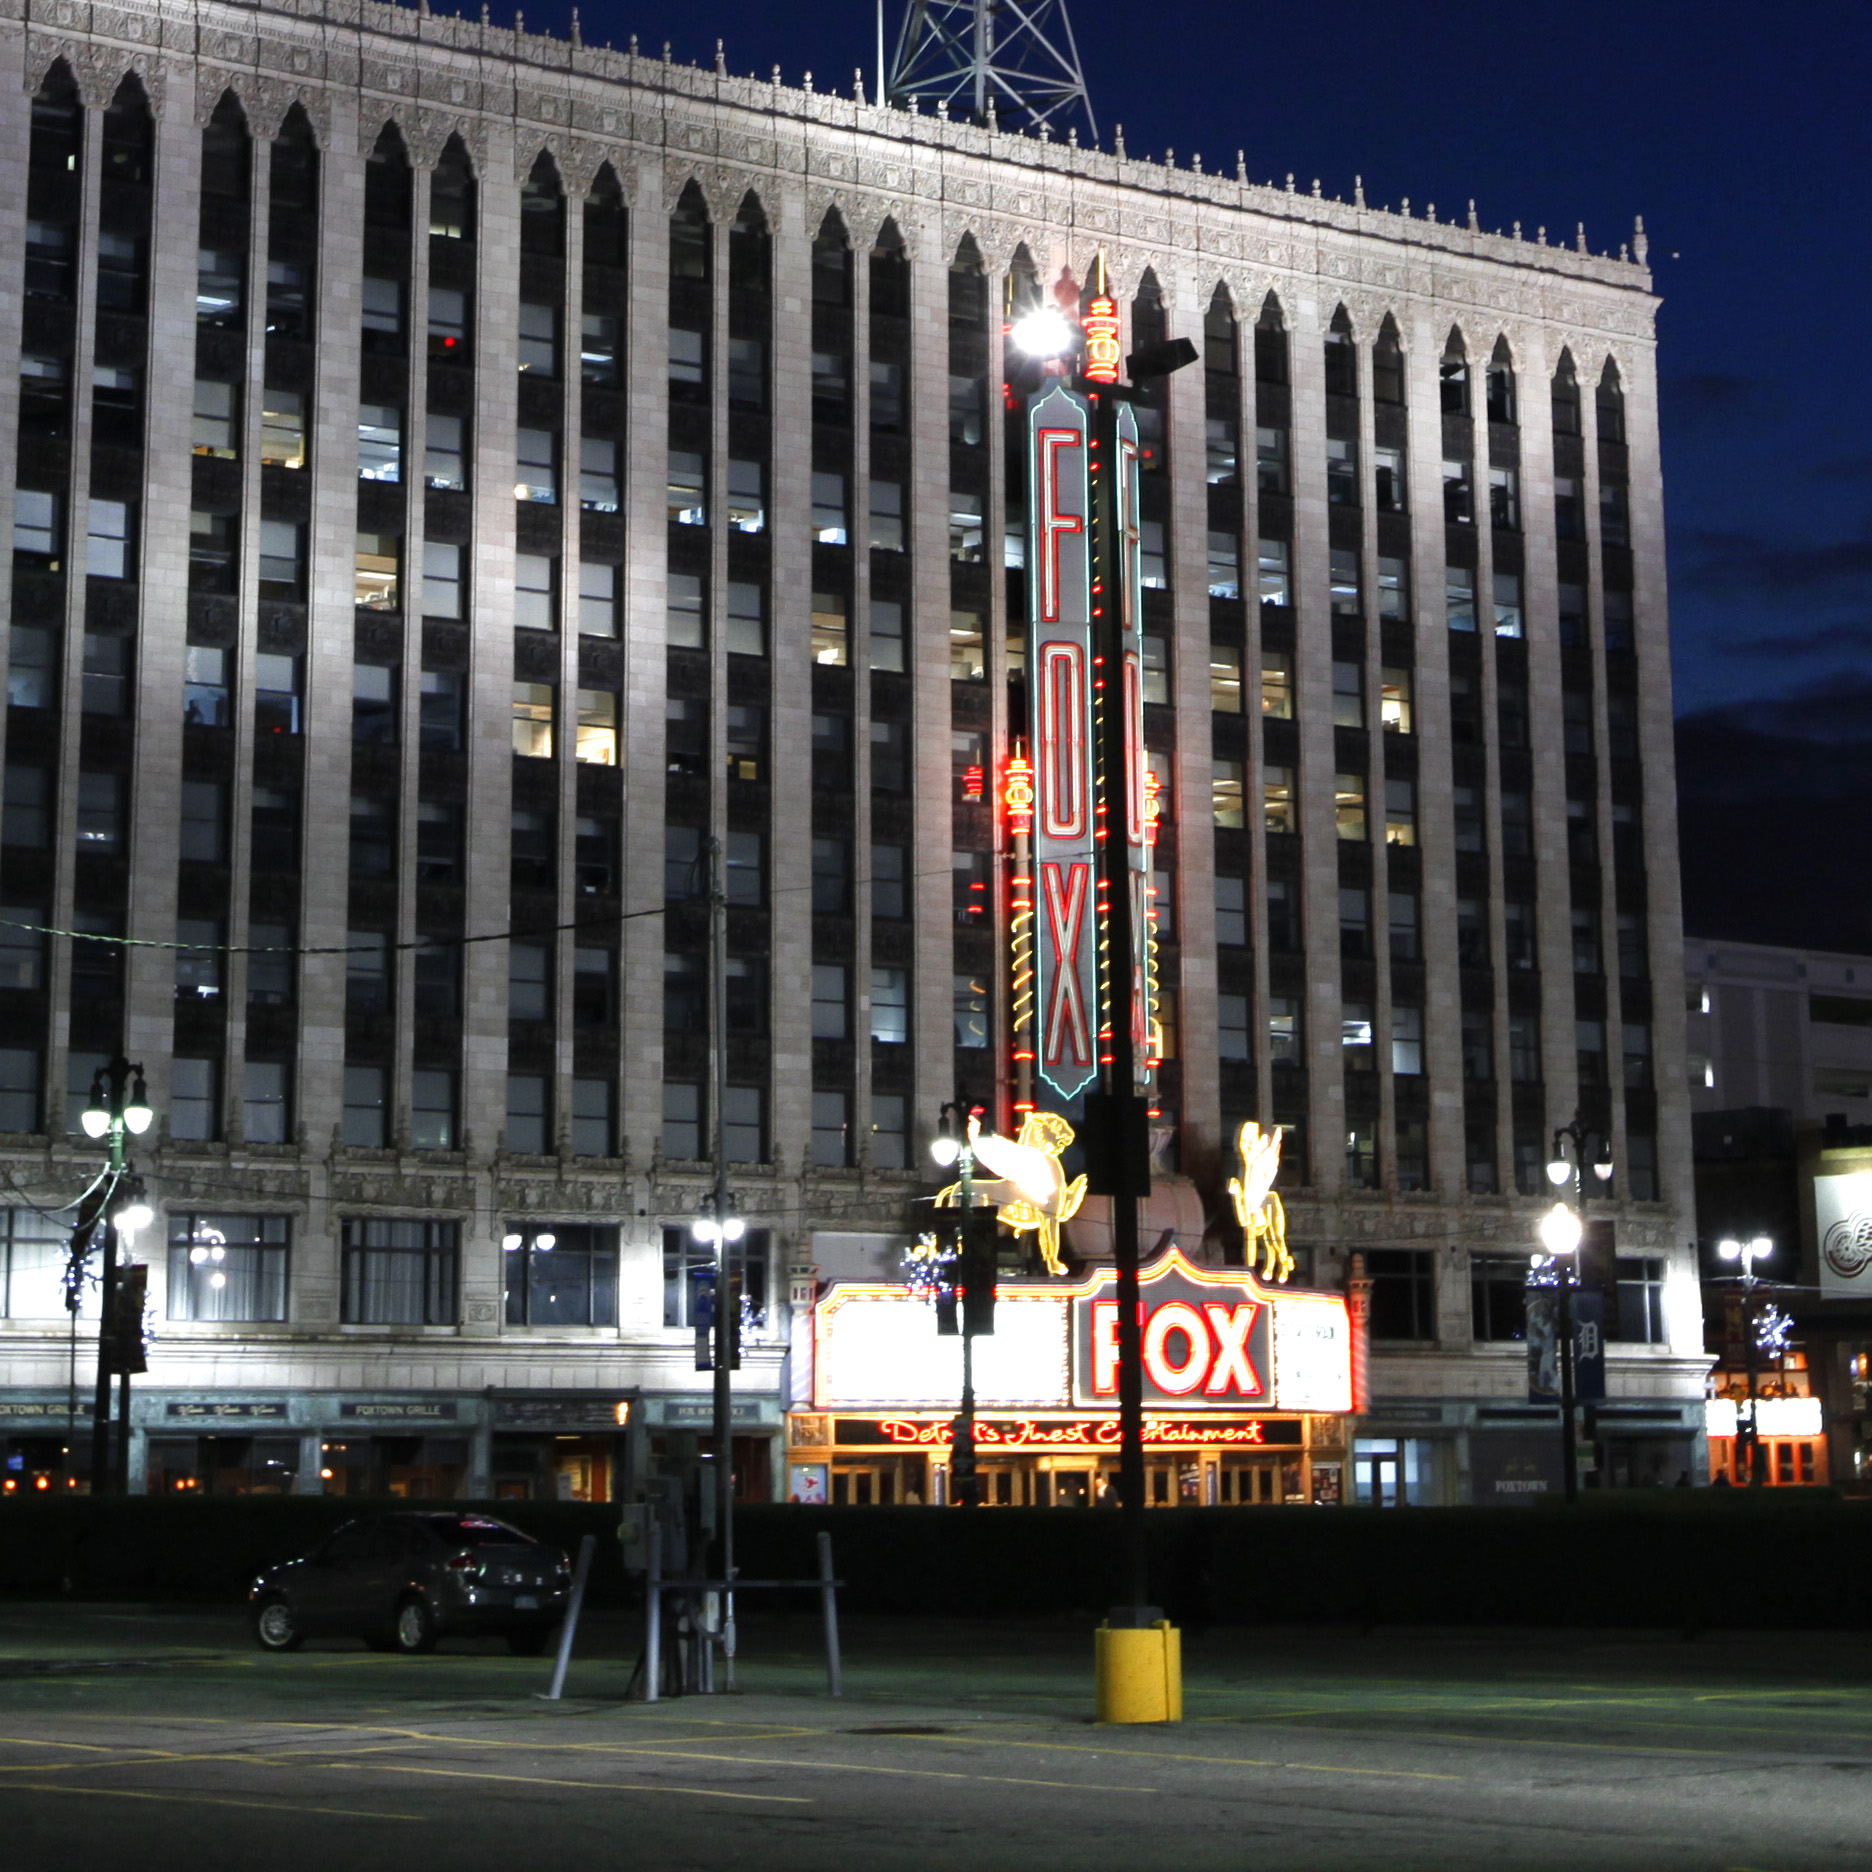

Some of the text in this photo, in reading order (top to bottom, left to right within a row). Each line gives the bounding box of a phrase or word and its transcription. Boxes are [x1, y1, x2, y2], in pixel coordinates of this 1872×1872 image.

[1039, 428, 1091, 1065] FOX
[1091, 1299, 1264, 1396] FOX
[355, 1405, 404, 1416] FOXTOWN
[879, 1419, 1264, 1446] Detrt's Finest Eertainment
